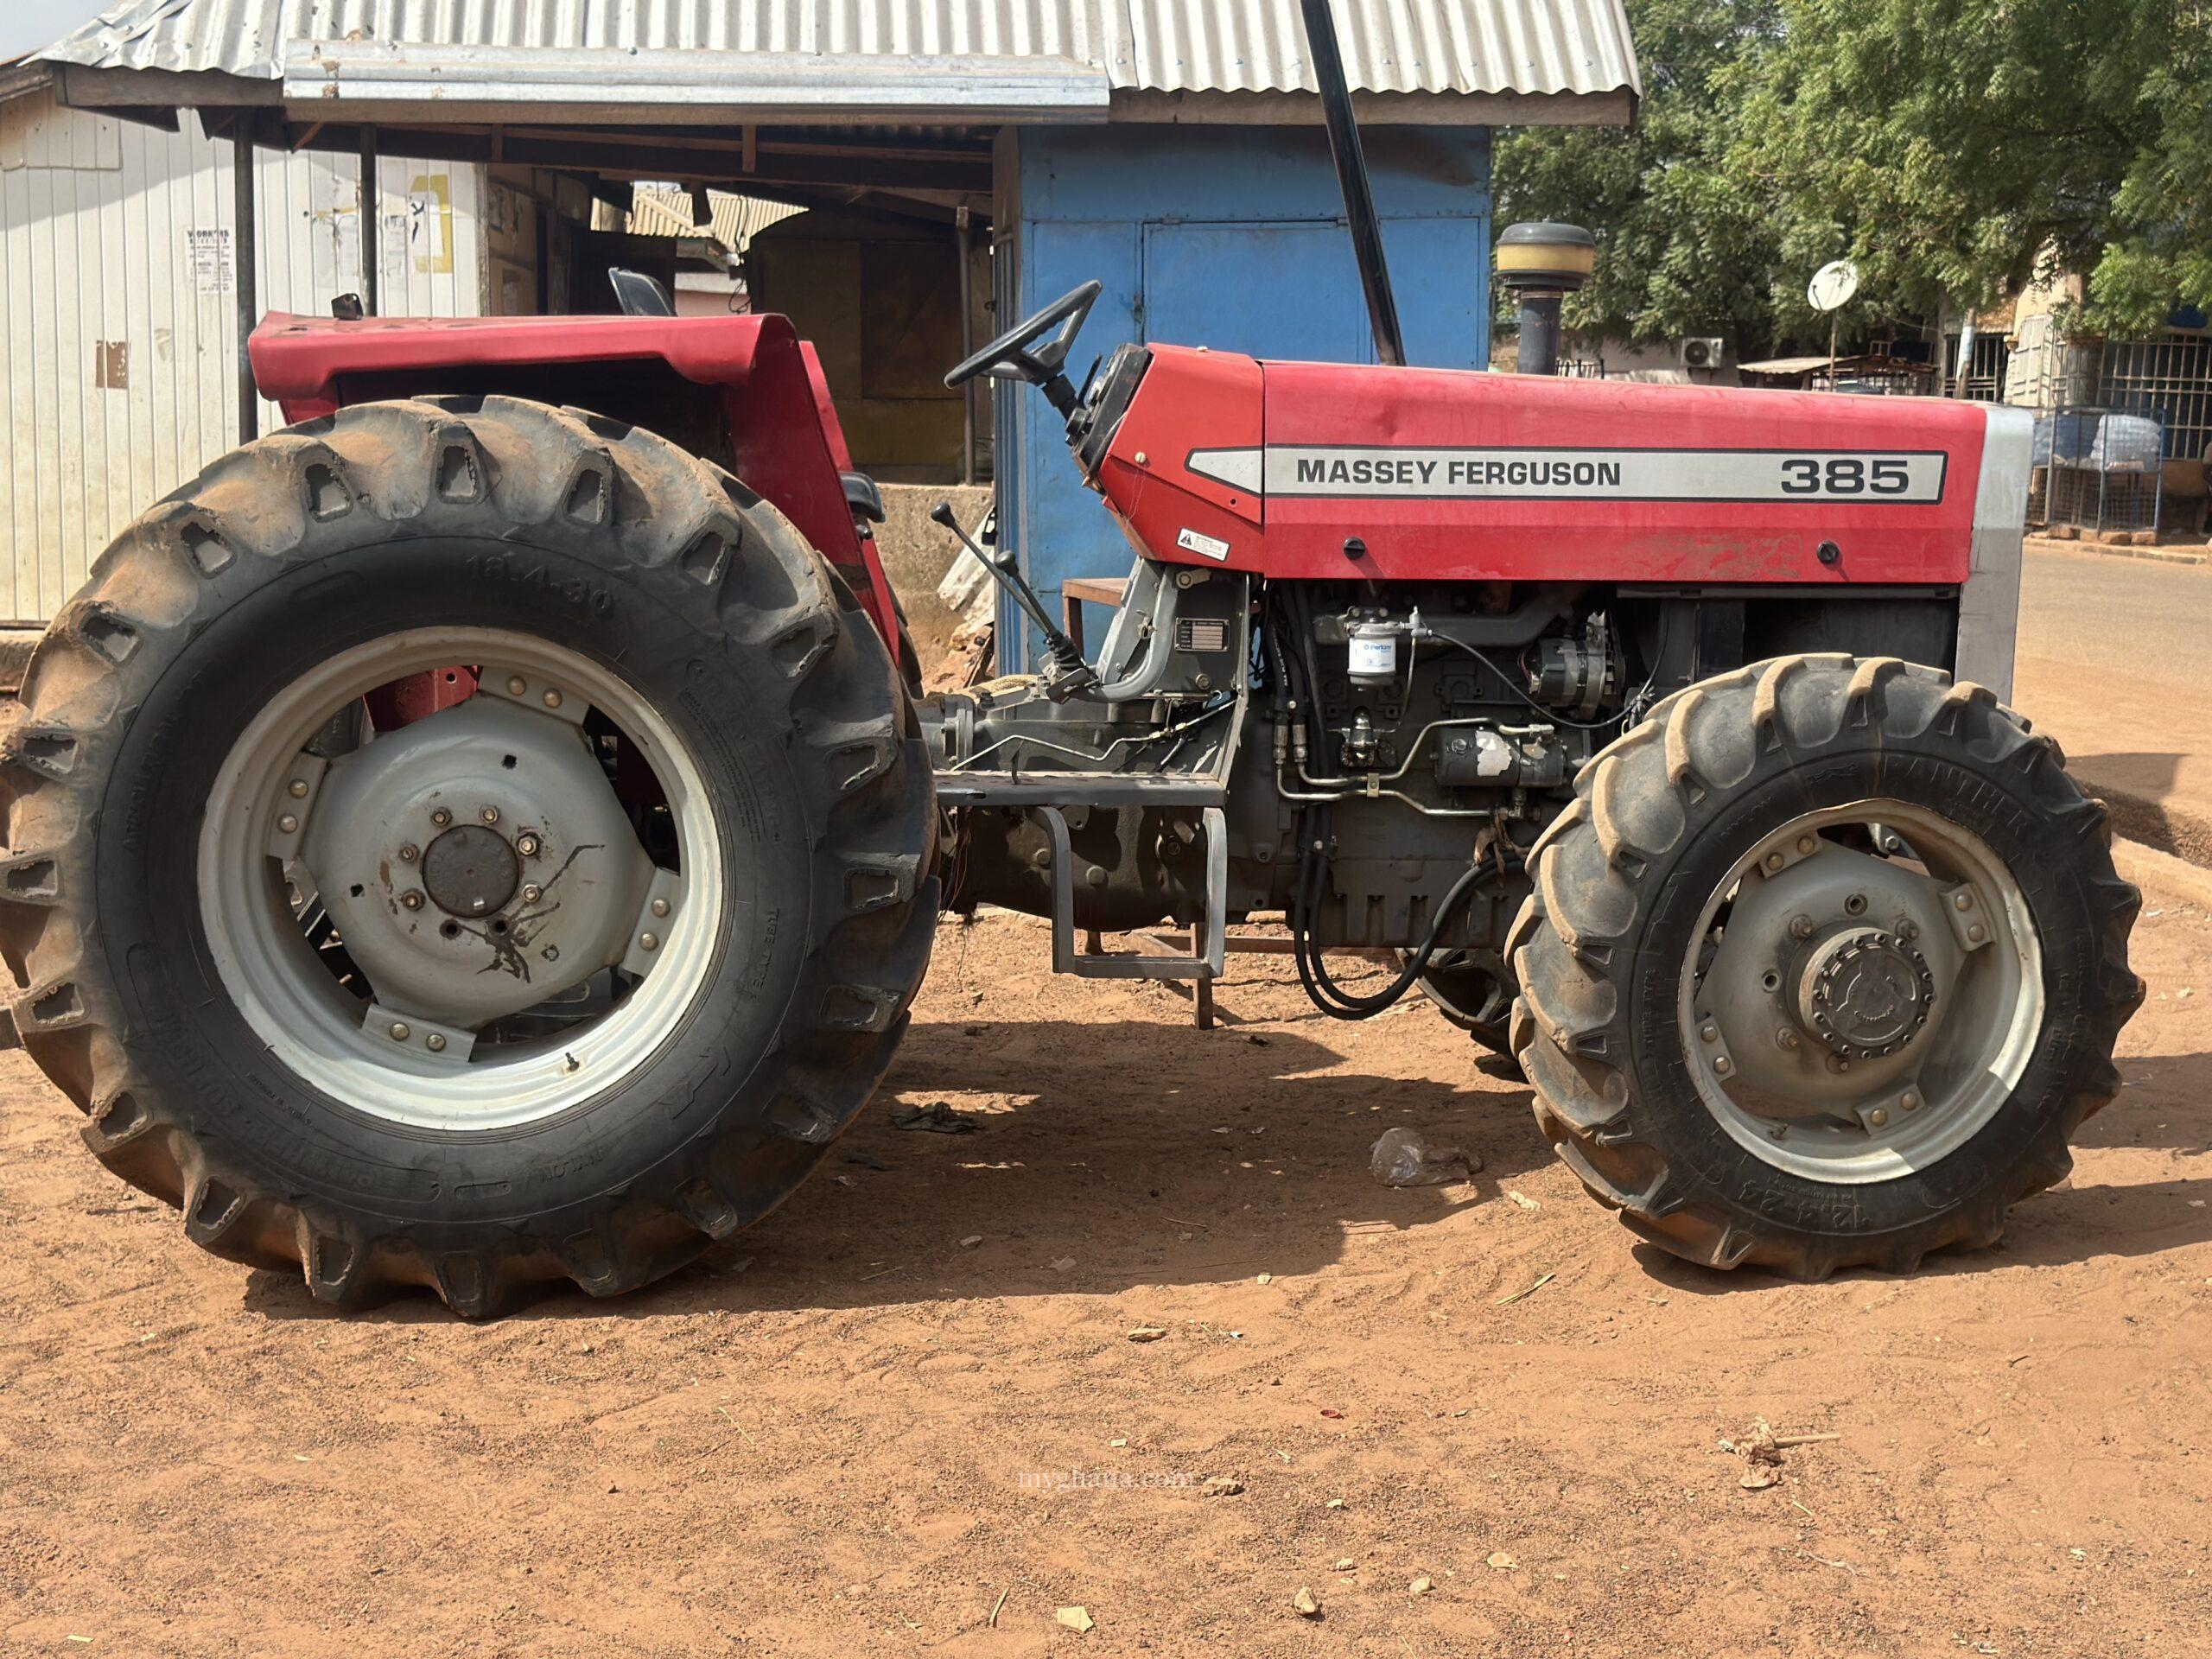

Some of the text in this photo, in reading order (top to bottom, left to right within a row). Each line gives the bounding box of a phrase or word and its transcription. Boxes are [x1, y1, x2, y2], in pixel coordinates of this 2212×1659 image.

[1297, 459, 1620, 486] MASSEY FERGUSON
[1782, 460, 1909, 493] 385
[753, 907, 779, 989] TUBE TYPE
